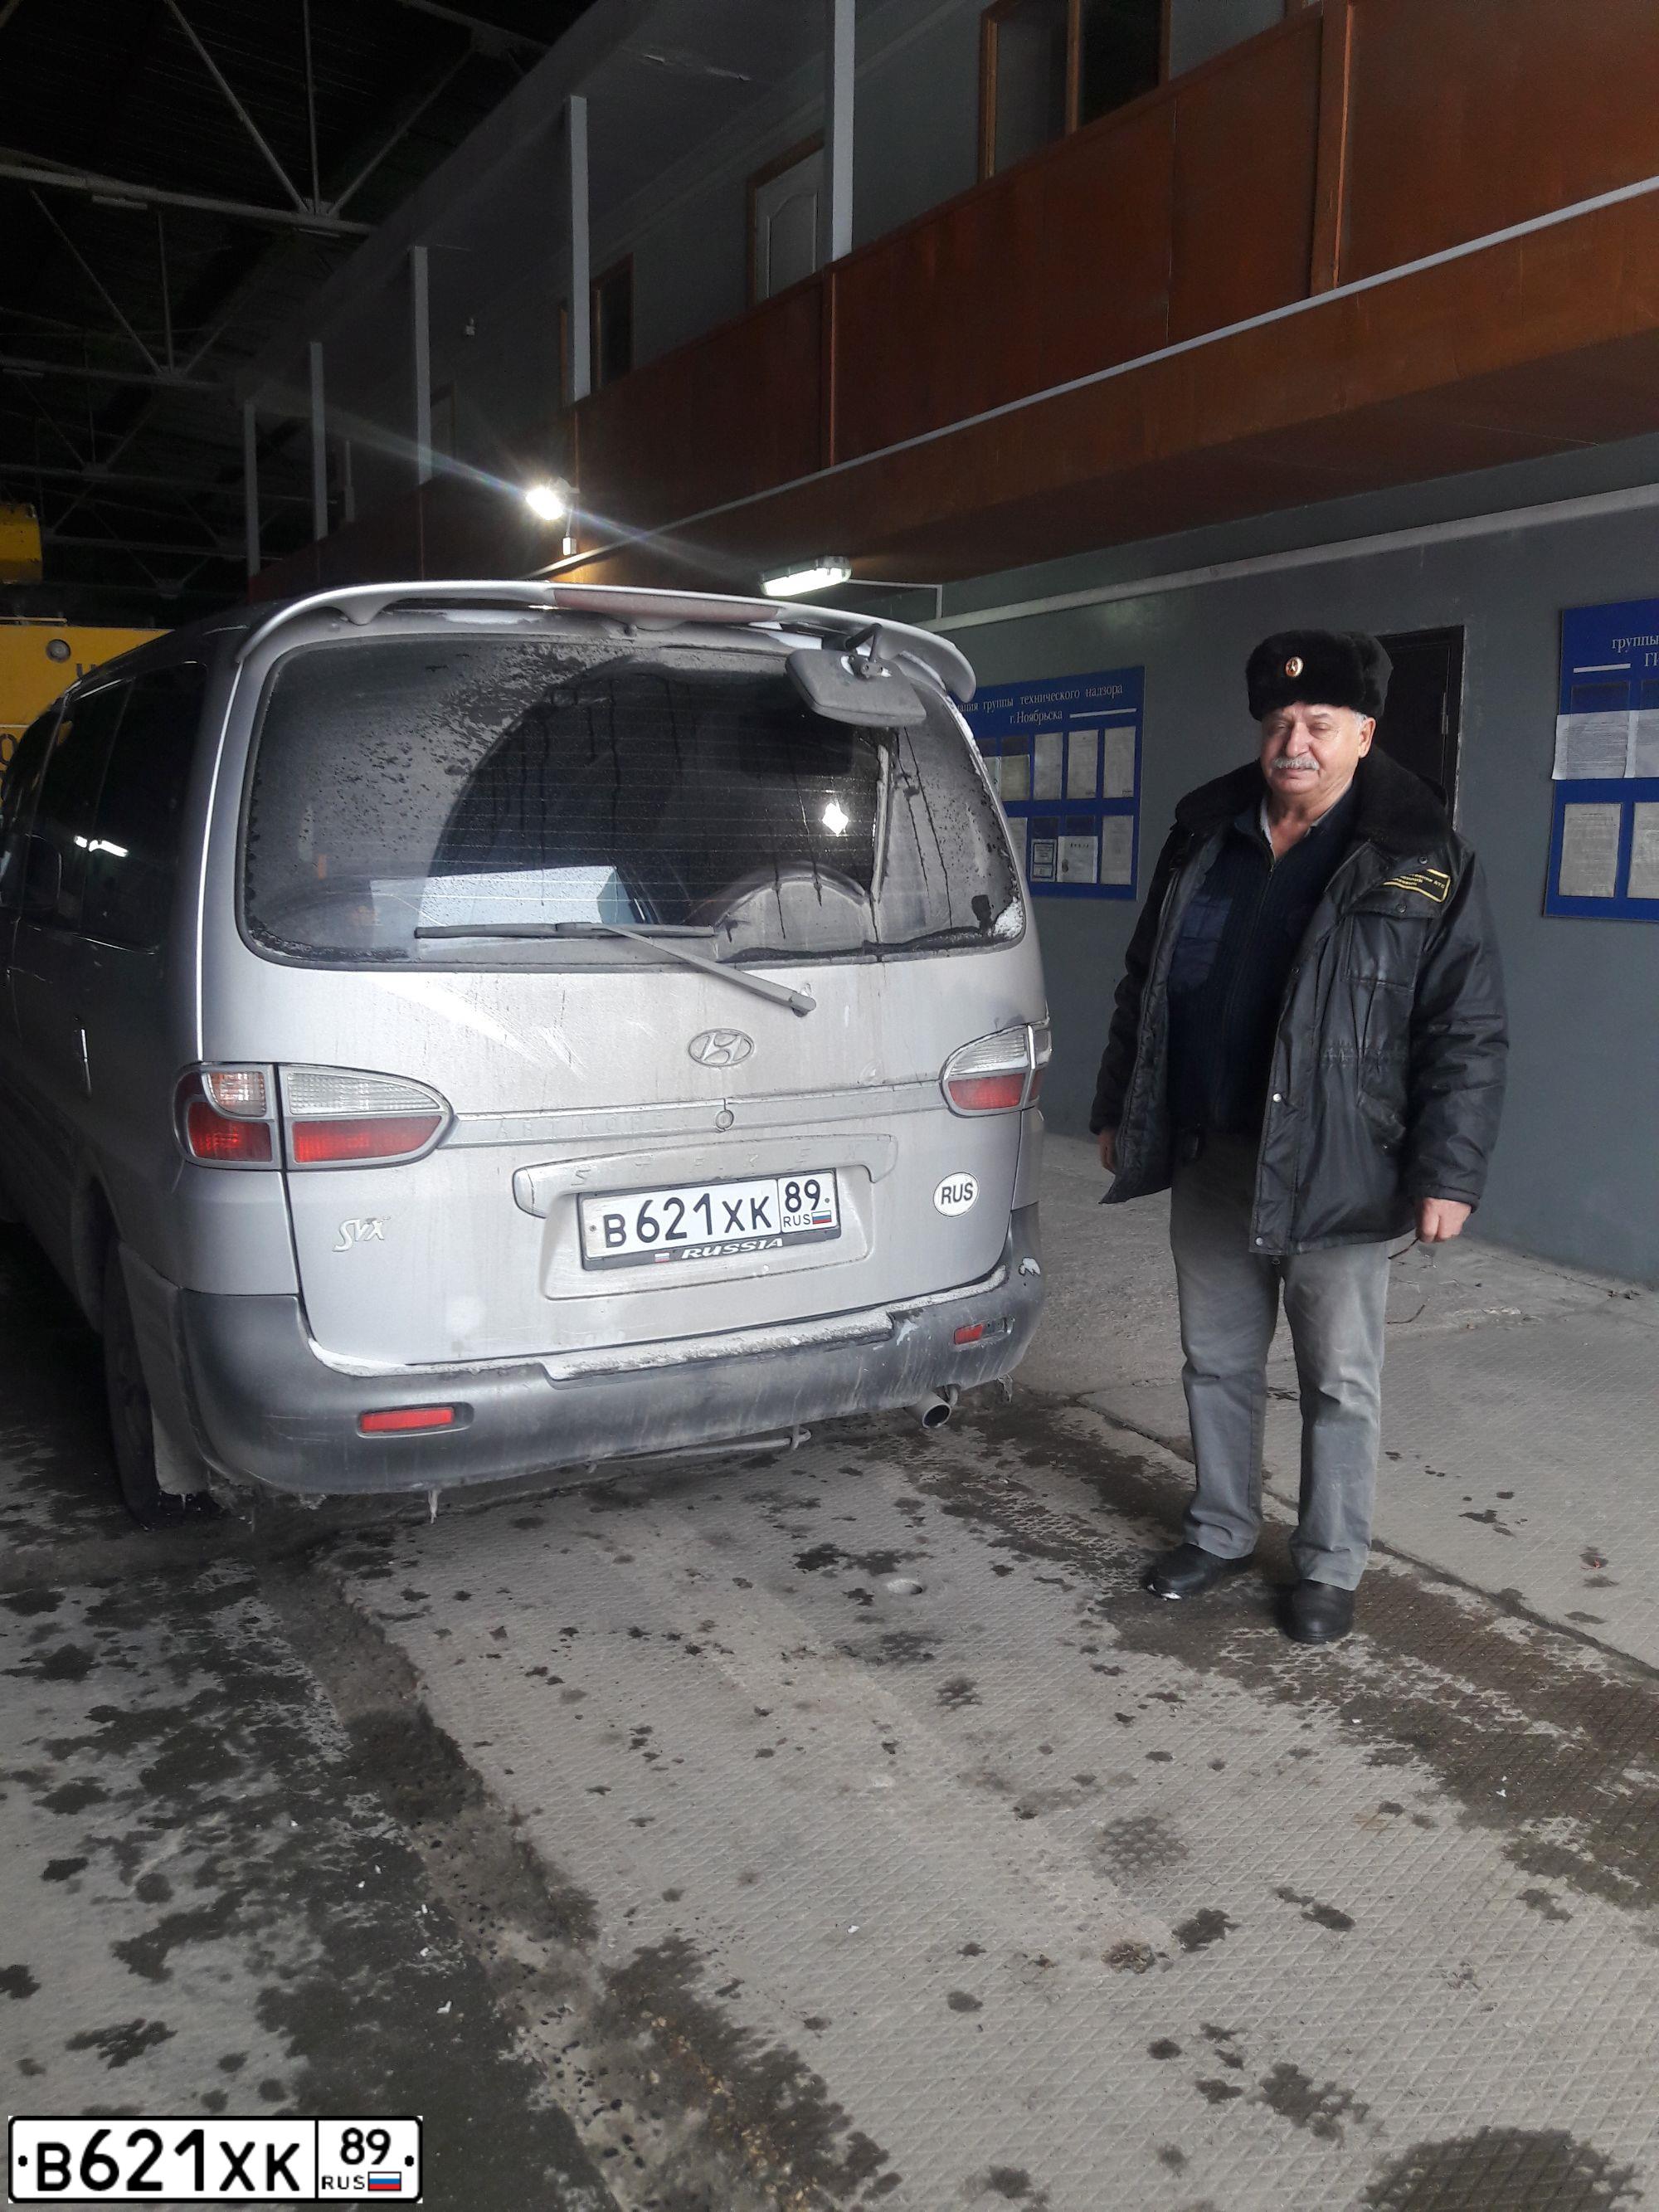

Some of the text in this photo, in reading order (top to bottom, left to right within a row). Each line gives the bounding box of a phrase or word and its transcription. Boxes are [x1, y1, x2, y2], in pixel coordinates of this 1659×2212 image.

[983, 698, 1014, 714] группы
[1019, 689, 1080, 705] технического
[1085, 684, 1124, 699] надзора
[1010, 709, 1063, 726] г.Ноябрьска
[940, 1182, 975, 1206] RUS
[603, 1178, 821, 1249] В621ХК 89
[782, 1213, 811, 1229] RUS
[680, 1237, 785, 1260] RUSSIA
